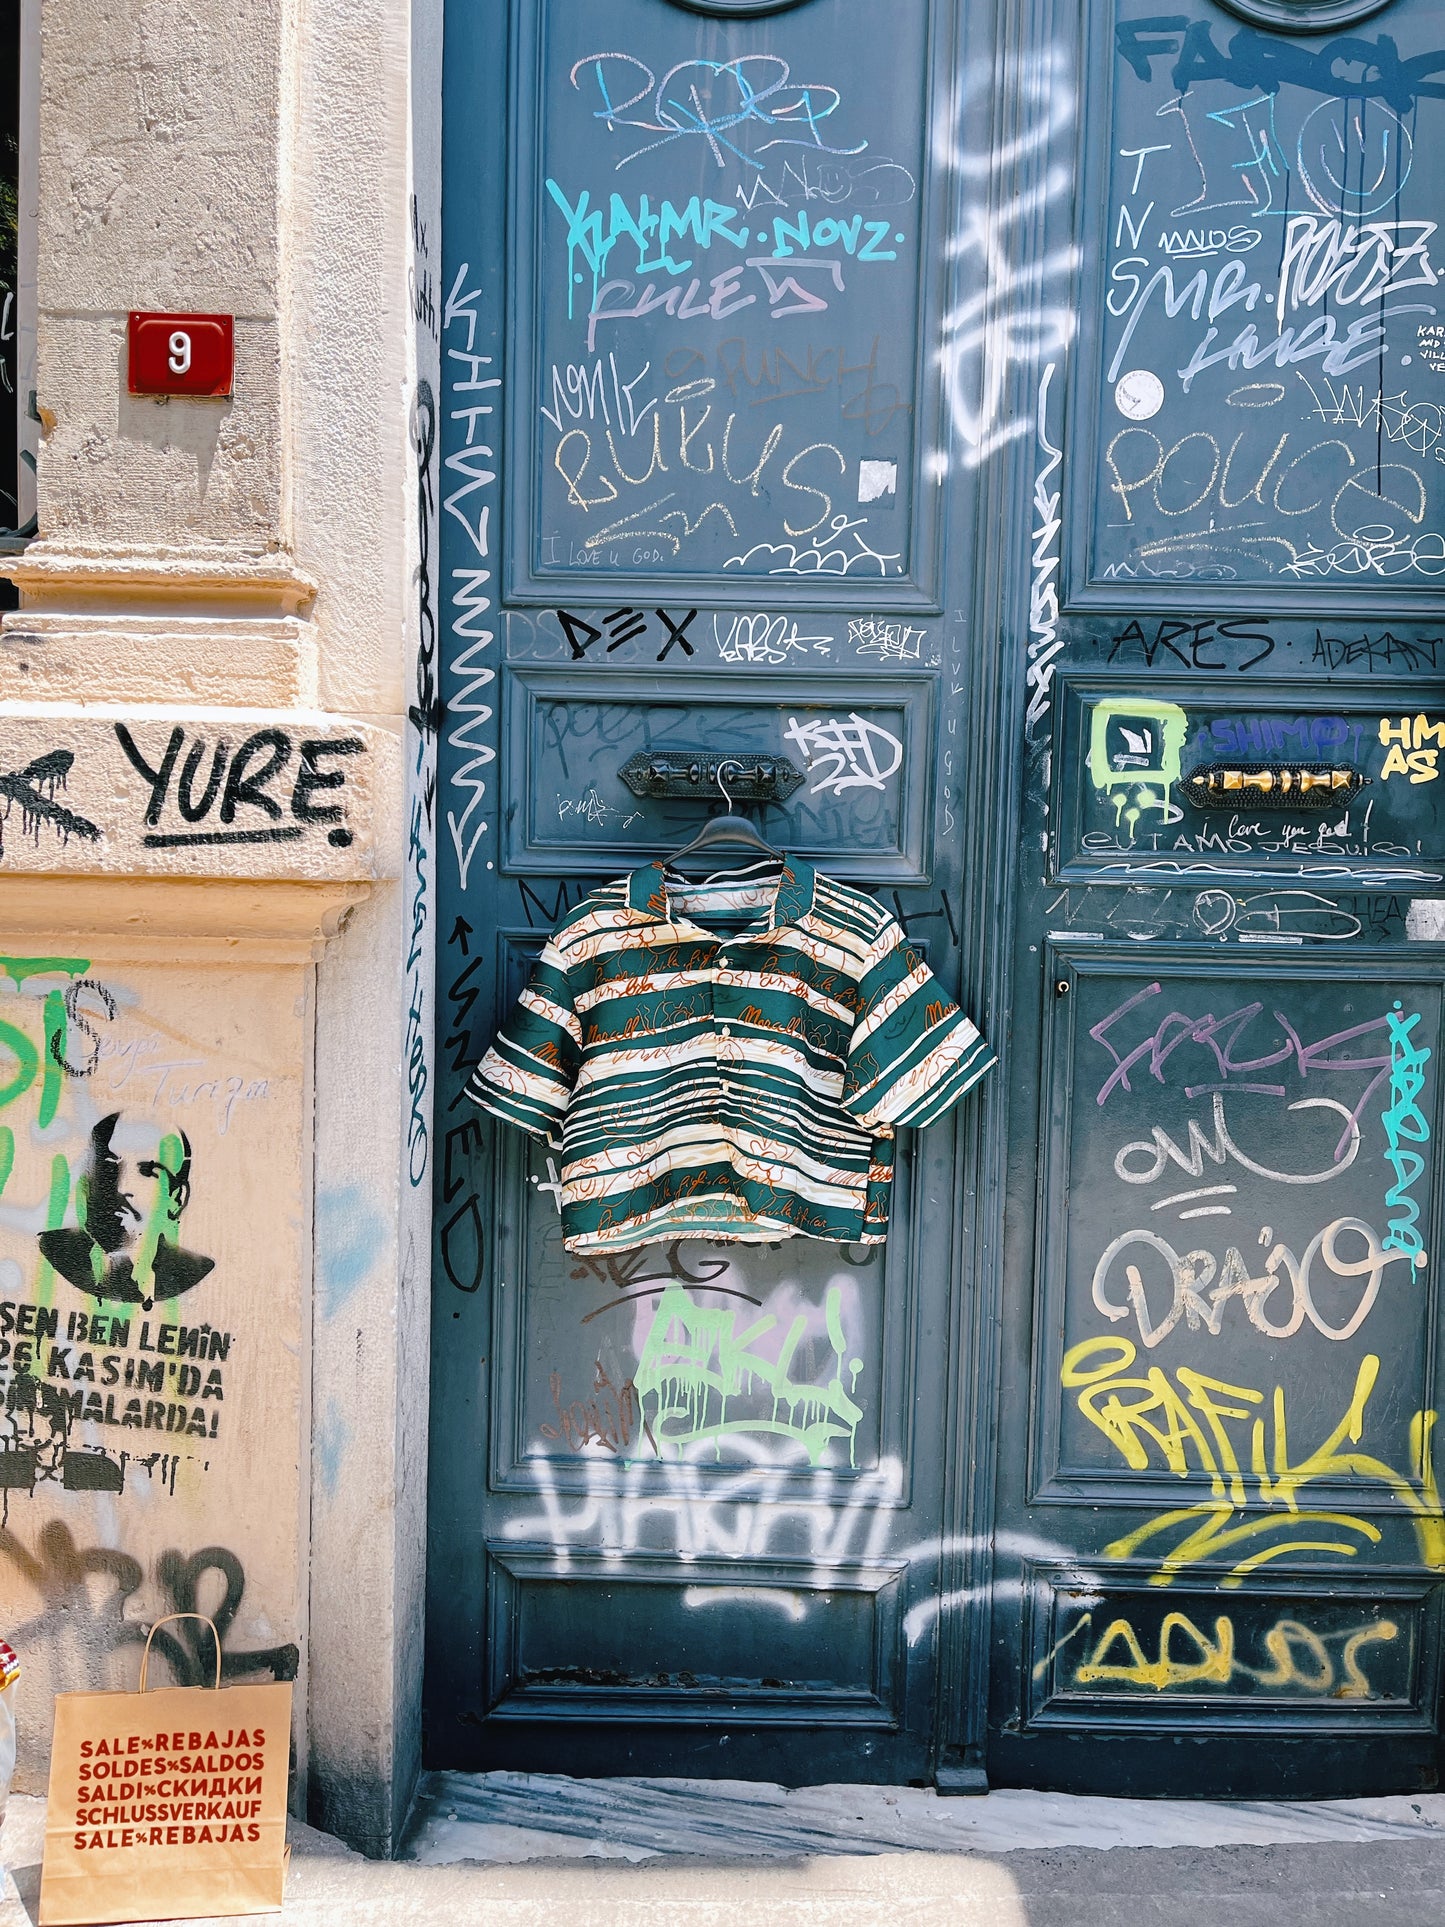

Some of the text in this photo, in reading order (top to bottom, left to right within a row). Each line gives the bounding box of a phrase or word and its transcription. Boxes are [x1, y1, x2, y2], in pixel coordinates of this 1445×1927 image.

[168, 331, 191, 375] 9
[569, 541, 604, 567] LOVE
[1107, 619, 1276, 671] ARES
[0, 1301, 58, 1338] SEN
[67, 1310, 131, 1349] BEN
[75, 1800, 262, 1827] SCHLUSSVERKAUF
